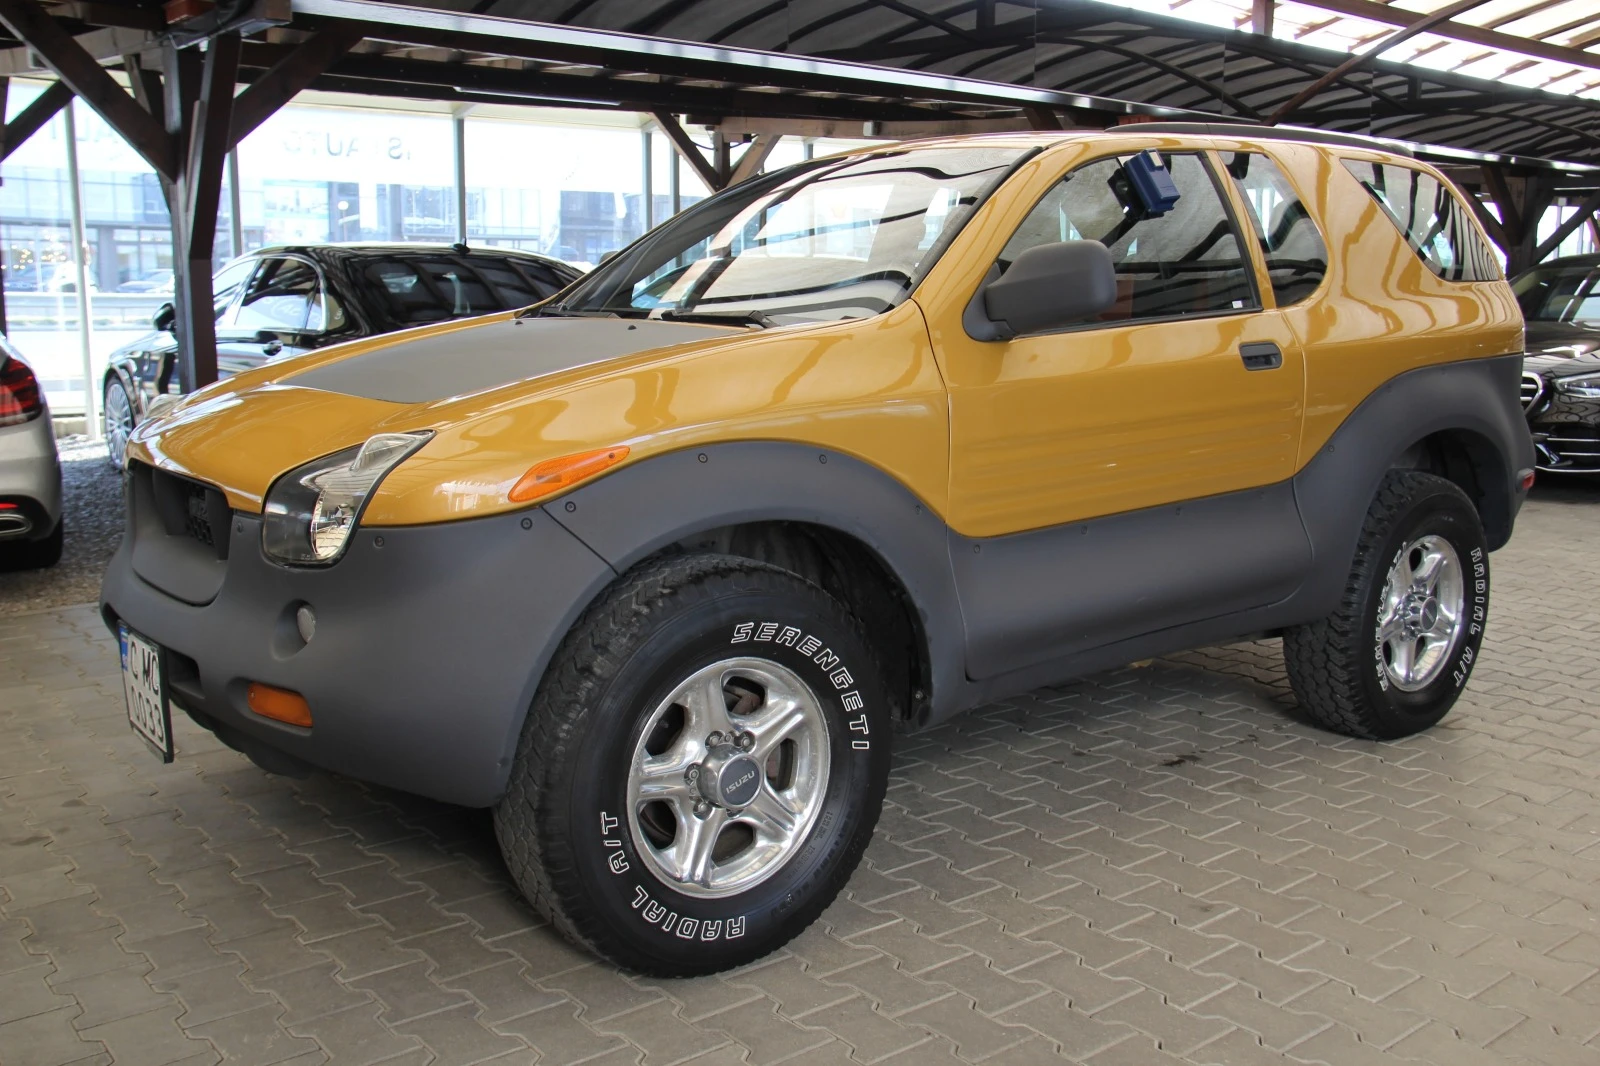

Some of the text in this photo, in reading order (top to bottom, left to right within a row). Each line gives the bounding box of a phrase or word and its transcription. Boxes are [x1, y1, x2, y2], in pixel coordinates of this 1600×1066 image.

[1470, 547, 1486, 636] RADIAL
[131, 685, 164, 743] 0033
[731, 622, 869, 750] SERENGETI
[726, 770, 755, 794] ISUZU
[632, 885, 745, 941] RADIAL
